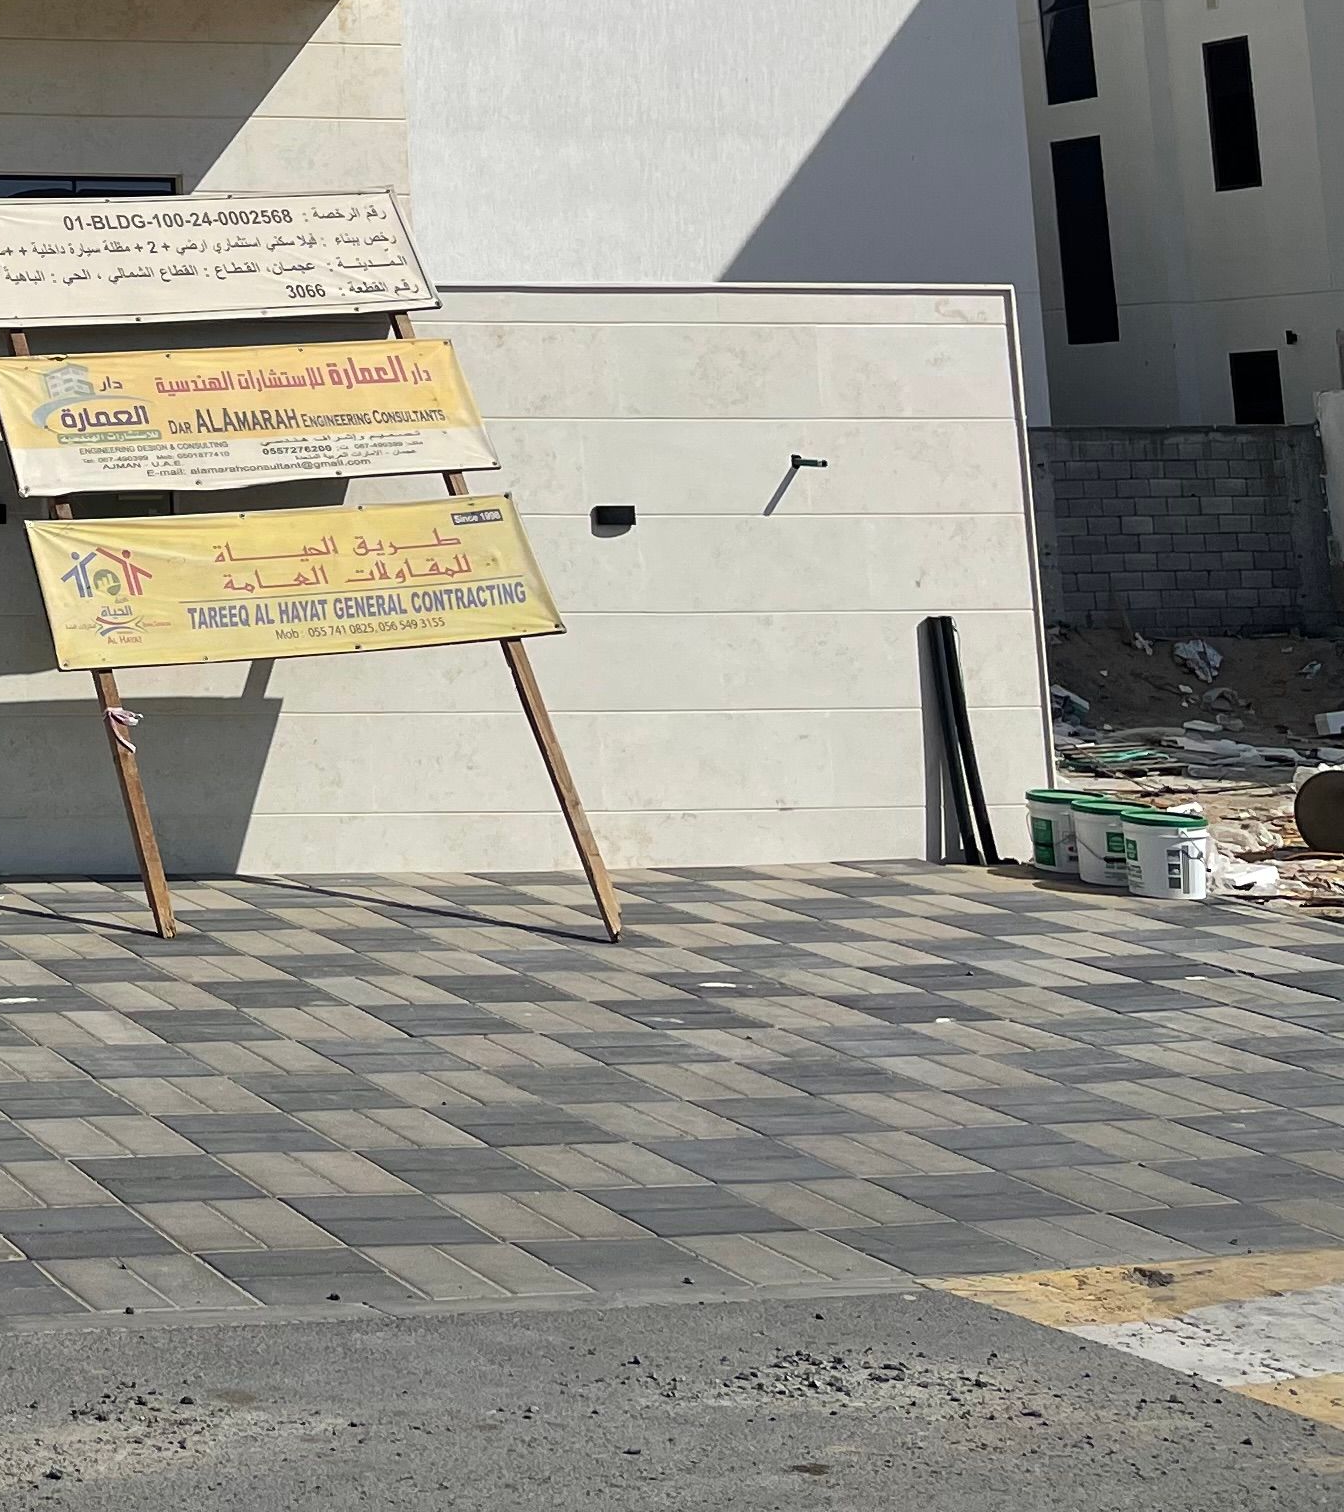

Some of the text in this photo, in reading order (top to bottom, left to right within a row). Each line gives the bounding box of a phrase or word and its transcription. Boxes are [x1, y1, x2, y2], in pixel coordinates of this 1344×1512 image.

[63, 209, 293, 231] 01-BLDG-100-24-0002568
[312, 208, 360, 222] الرخصة
[366, 205, 386, 222] رقم
[103, 240, 131, 253] مظلة
[212, 236, 261, 252] استثماري
[265, 236, 295, 252] سكني
[364, 232, 397, 246] رخص
[32, 241, 66, 259] داخلية
[68, 243, 100, 258] سيارة
[147, 241, 158, 254] 2
[176, 240, 208, 256] ارضي
[62, 270, 91, 285] الحي
[108, 266, 155, 284] الشمالي
[159, 265, 199, 282] القطاع
[214, 262, 260, 279] القطاع
[285, 284, 326, 299] 3066
[349, 283, 389, 295] القطعة
[394, 279, 419, 296] رقم
[325, 355, 409, 390] العمارة
[411, 362, 432, 385] دار
[99, 376, 123, 392] دار
[154, 370, 235, 397] الهندسية
[60, 405, 150, 433] العمارة
[79, 446, 136, 455] ENGINEERING
[137, 444, 169, 453] DESIGN
[177, 441, 229, 451] CONSULTING
[102, 462, 142, 470] AJMAN
[147, 469, 187, 477] E-mail:
[454, 513, 479, 523] Since
[213, 528, 462, 563] طريق الحياة
[223, 552, 473, 594] للمقاولات العامة
[101, 606, 133, 619] الحياة
[188, 581, 527, 630] TAREEQ AL HAYAT GENERAL CONTRACTING
[275, 629, 299, 640] Mob
[308, 627, 328, 638] 055
[330, 625, 347, 635] 741
[378, 620, 398, 632] 056
[400, 619, 418, 630] 549
[421, 617, 446, 628] 3155
